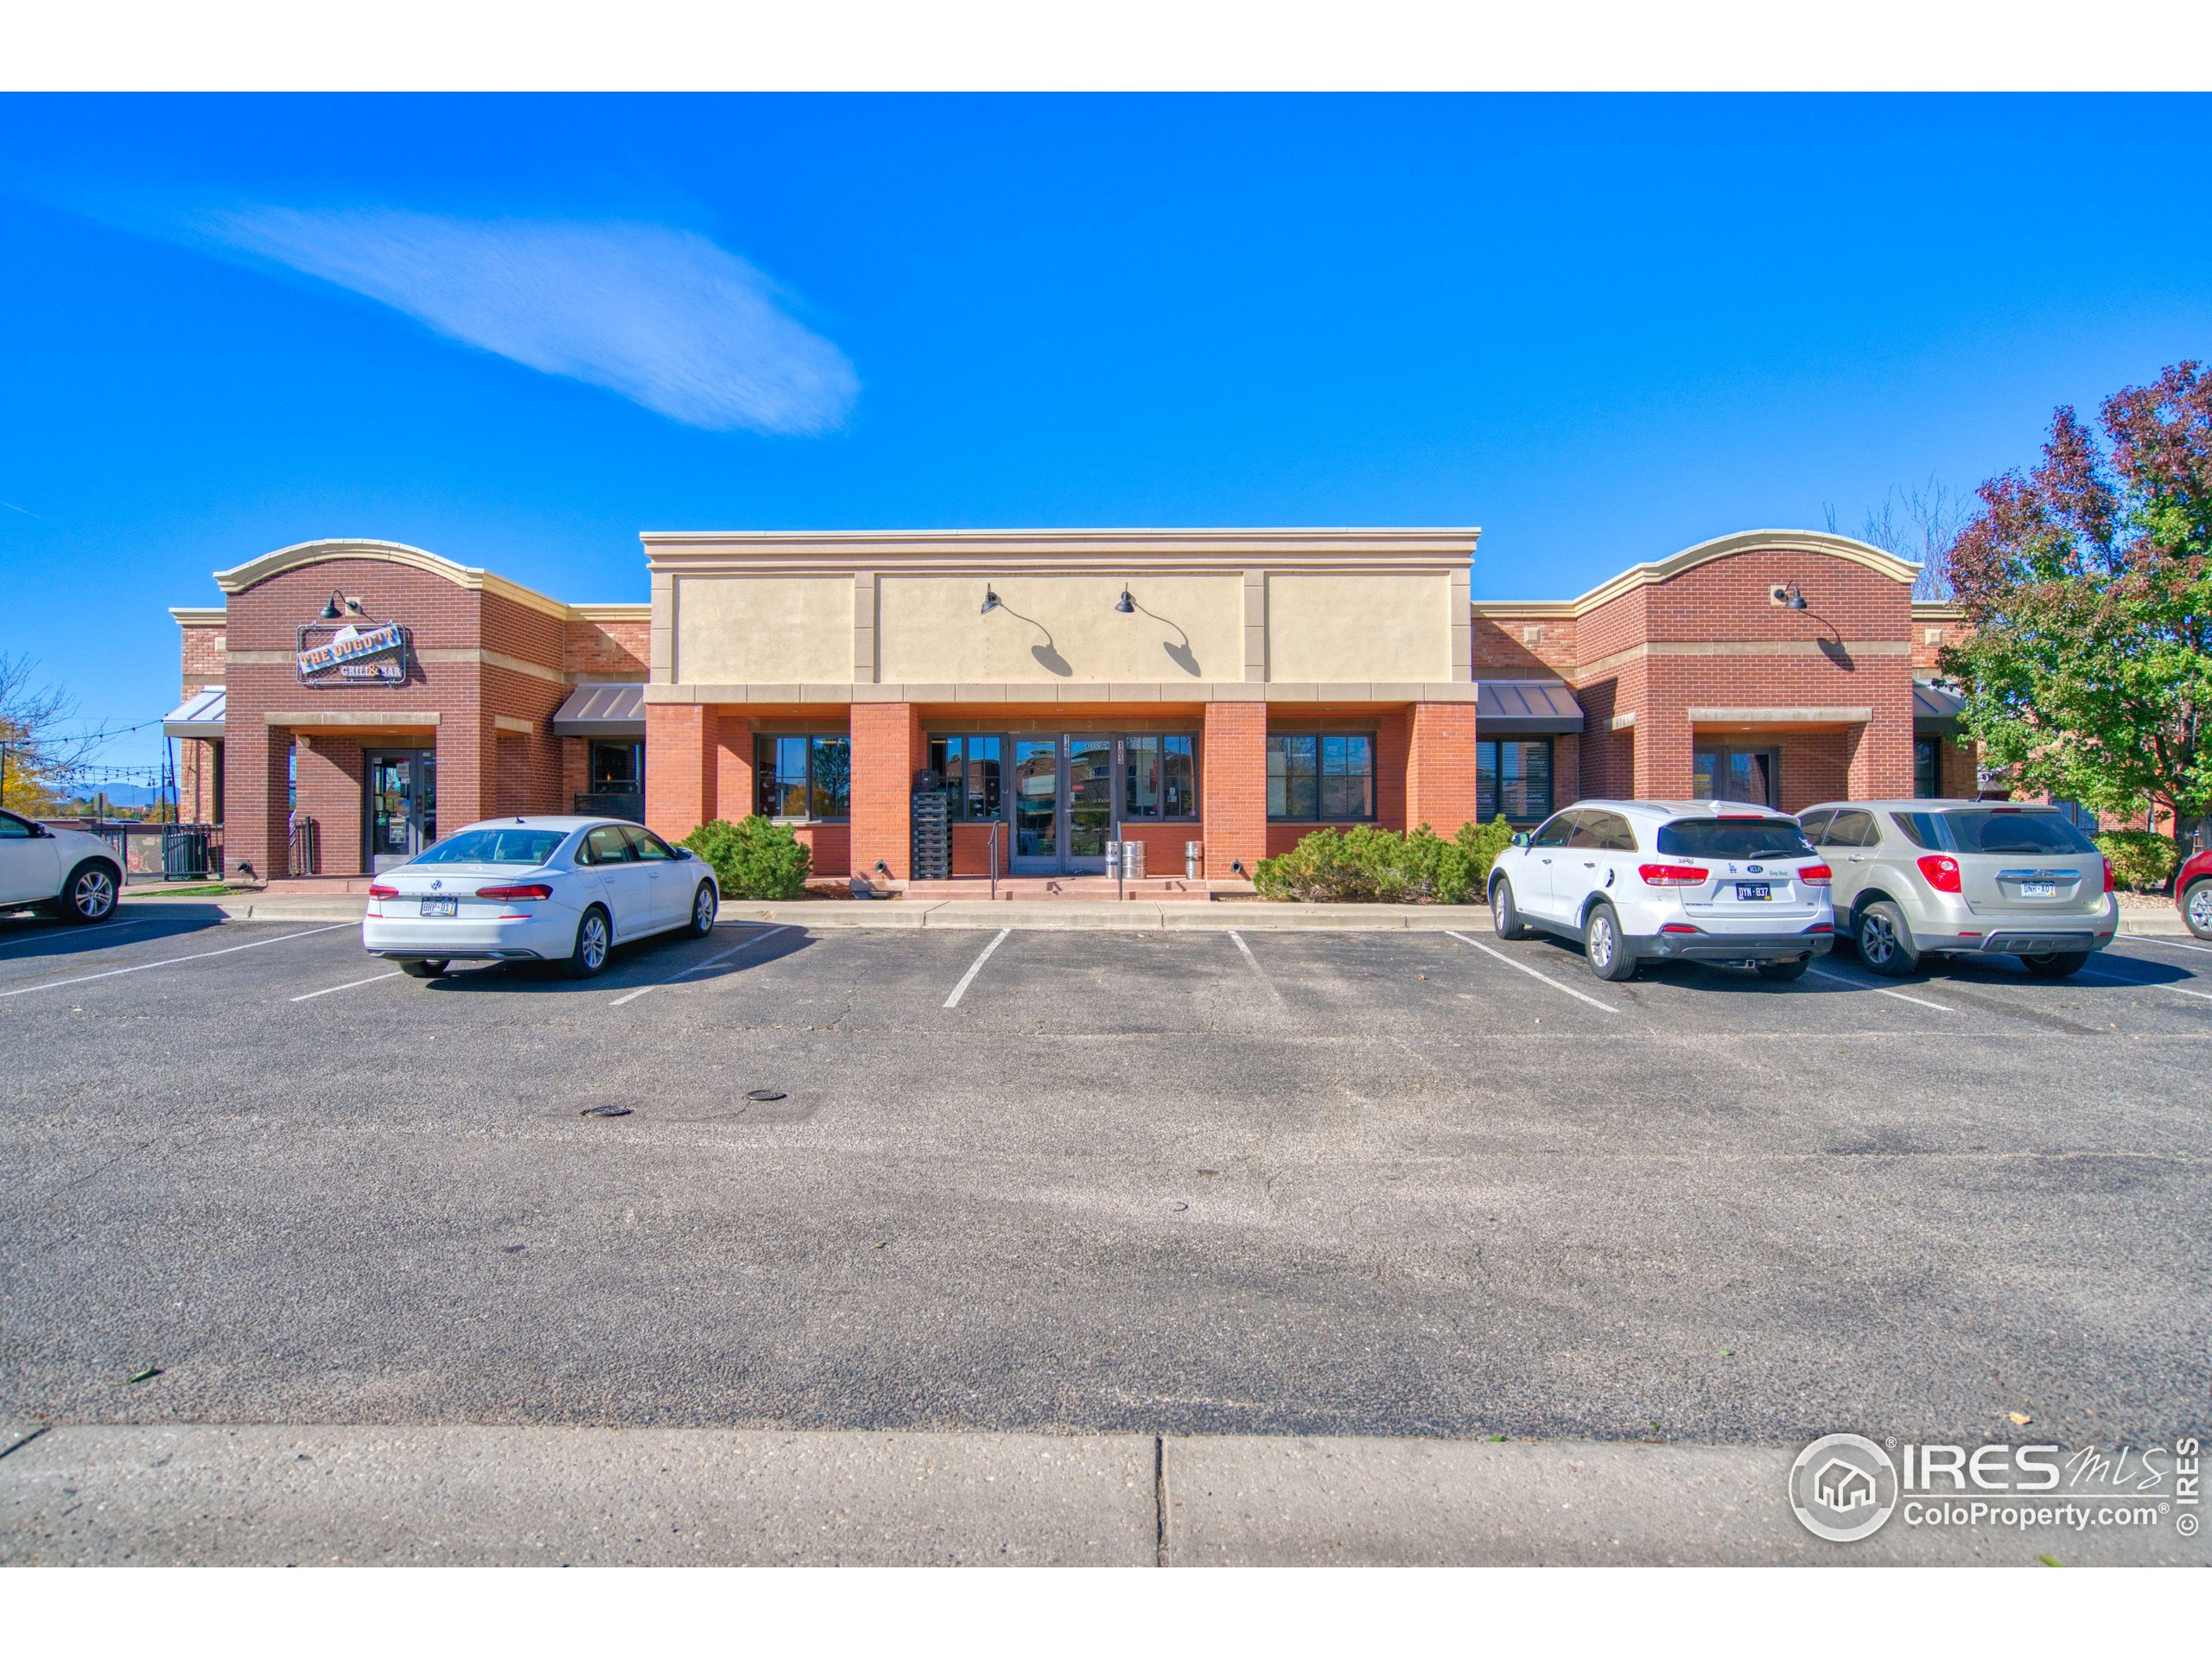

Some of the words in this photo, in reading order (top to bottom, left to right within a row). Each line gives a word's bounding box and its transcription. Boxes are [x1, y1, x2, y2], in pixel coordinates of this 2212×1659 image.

[300, 648, 331, 667] THE
[334, 629, 394, 658] DUGOUT
[341, 666, 369, 677] GRILL
[368, 664, 378, 677] &
